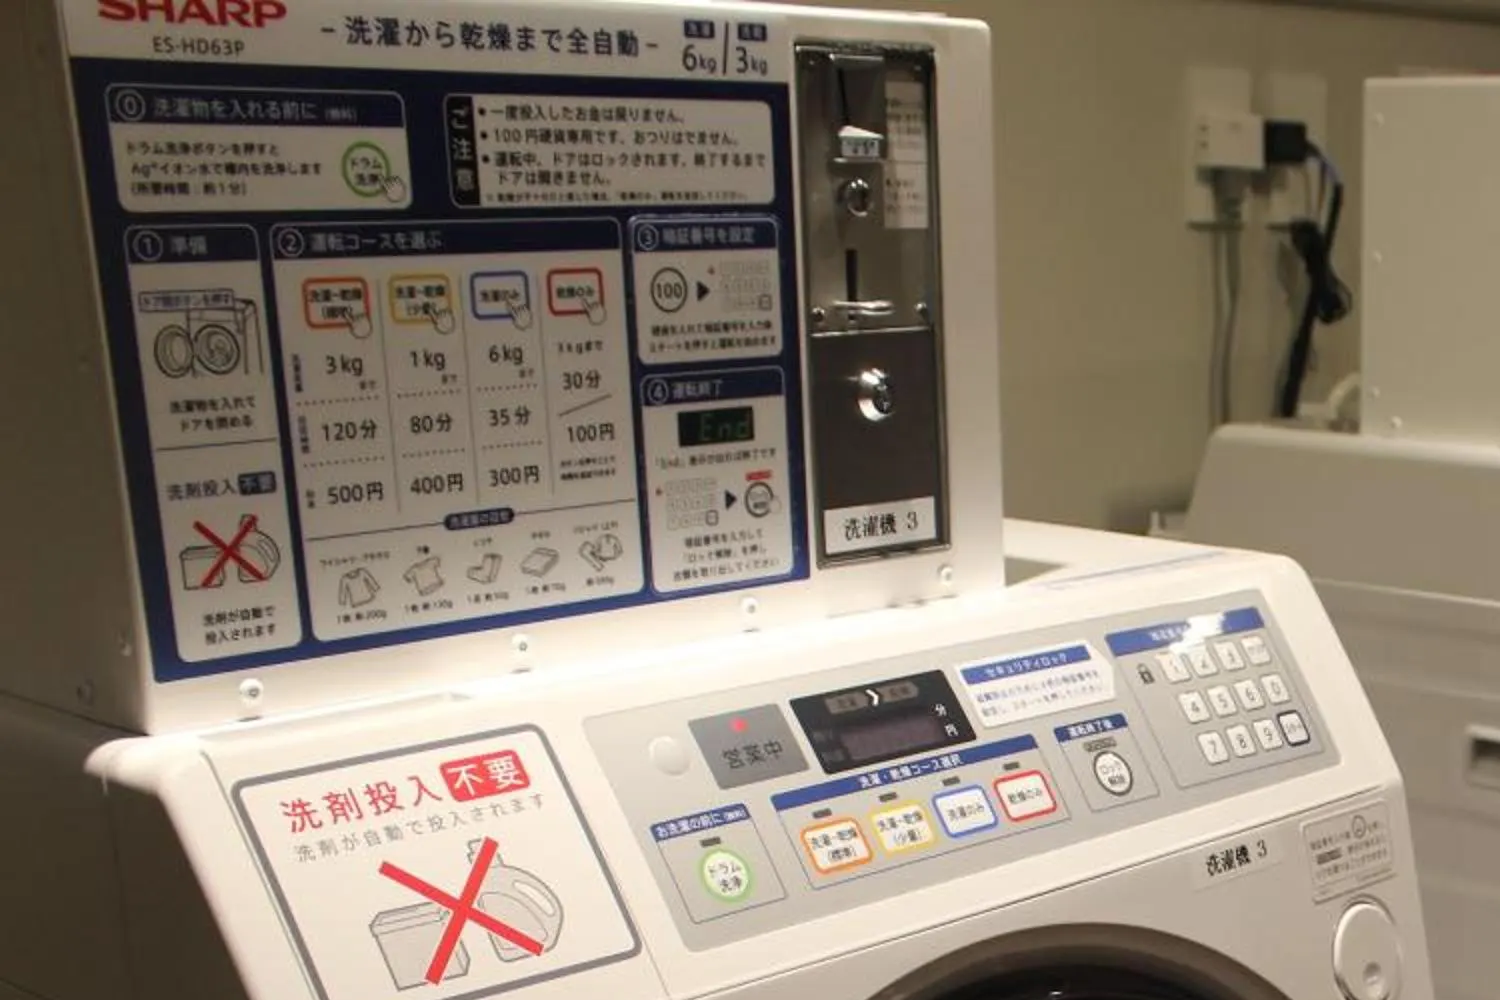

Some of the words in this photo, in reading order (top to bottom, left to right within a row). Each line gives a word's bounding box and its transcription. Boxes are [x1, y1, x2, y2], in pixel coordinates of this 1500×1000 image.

[97, 0, 287, 28] SHARP
[153, 36, 244, 56] ES-HD63P
[682, 45, 716, 73] 6kg
[736, 46, 767, 75] 3kg
[350, 156, 381, 170] ドラム
[656, 281, 682, 300] 100
[325, 354, 363, 376] 3kg
[410, 350, 446, 371] 1kg
[489, 344, 523, 366] 6kg
[561, 369, 601, 390] 30分
[409, 413, 453, 434] 80分
[488, 405, 531, 427] 35分
[321, 420, 378, 442] 120分
[567, 422, 615, 444] 100円
[409, 472, 464, 495] 400円
[488, 465, 540, 488] 300円
[167, 478, 237, 500] 洗剤投入
[327, 481, 384, 505] 500円
[843, 512, 897, 541] 洗濯機
[905, 510, 919, 532] 3
[721, 740, 783, 769] 営業中
[279, 775, 442, 833] 洗剤投入
[447, 756, 525, 796] 不要
[294, 793, 544, 863] 洗剤が自動で投入されます
[1206, 844, 1251, 876] 洗濯機
[1257, 839, 1267, 858] 3
